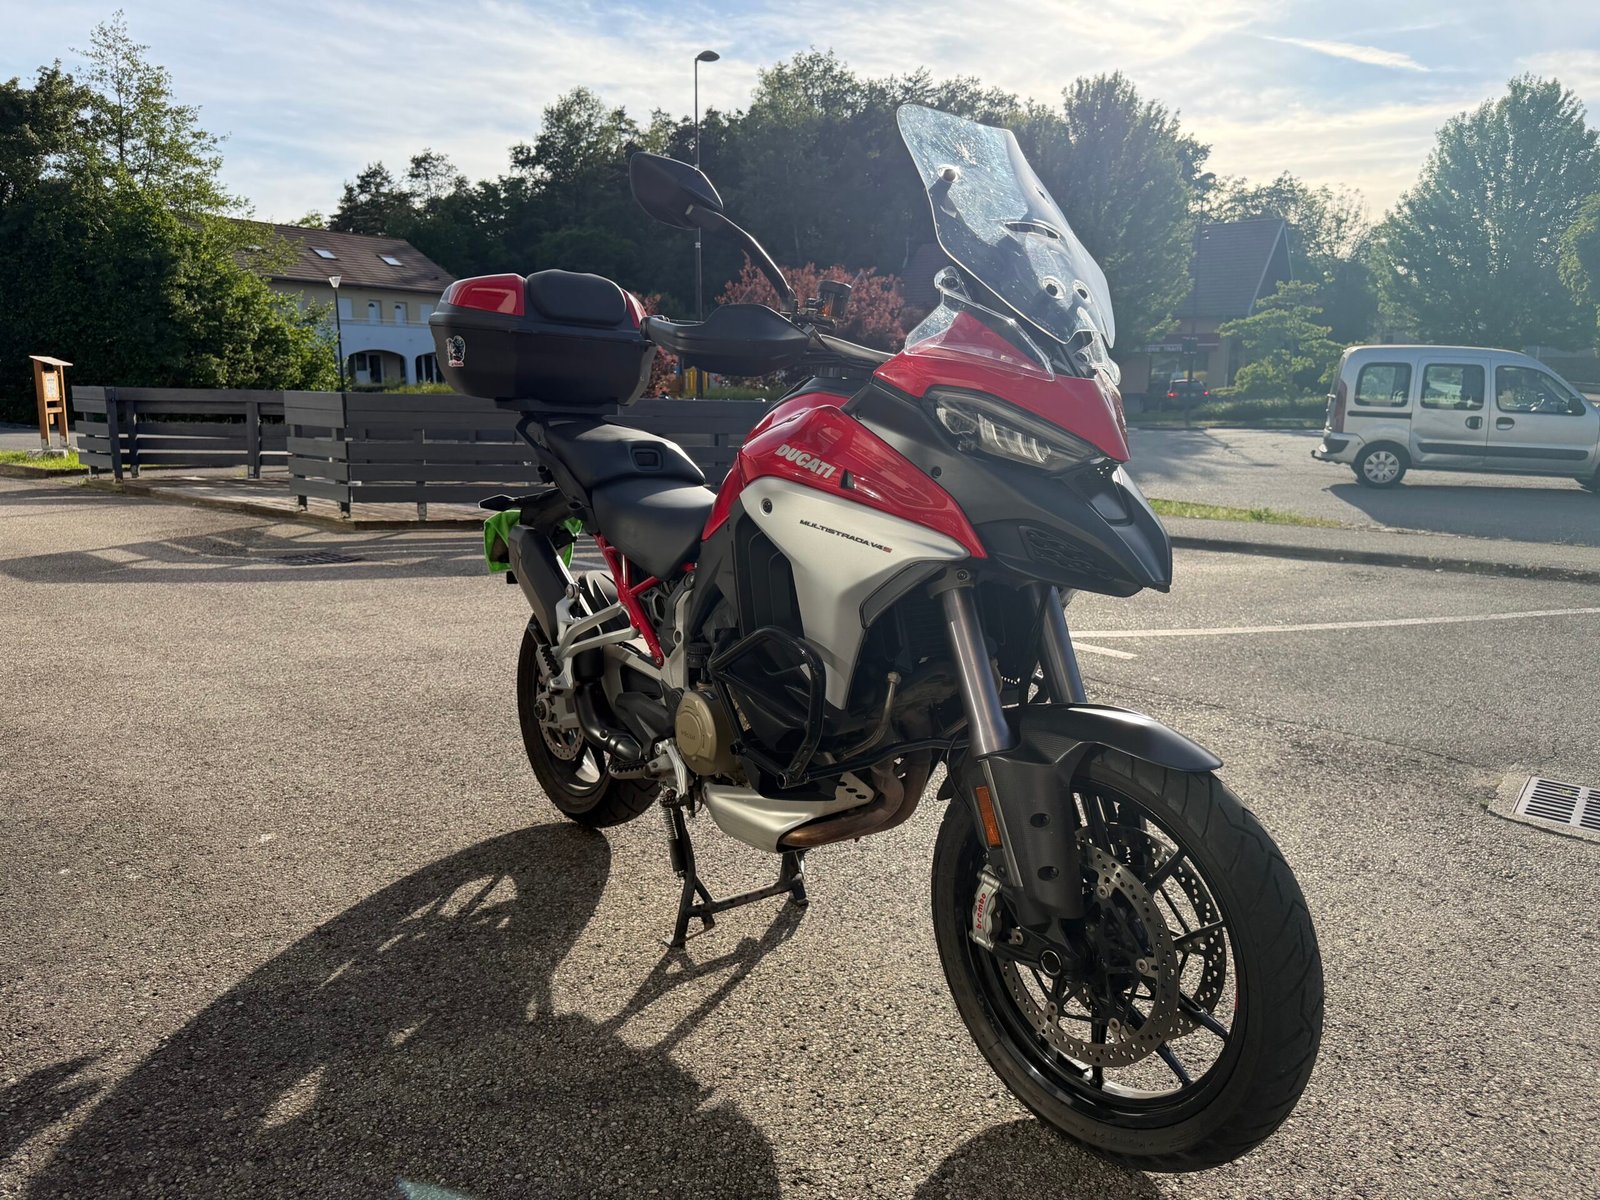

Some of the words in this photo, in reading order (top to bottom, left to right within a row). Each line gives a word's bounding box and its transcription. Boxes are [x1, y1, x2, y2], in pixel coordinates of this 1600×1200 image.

[774, 443, 836, 479] DUCATI
[799, 519, 870, 546] MULTISTRADA
[976, 892, 987, 929] brembo
